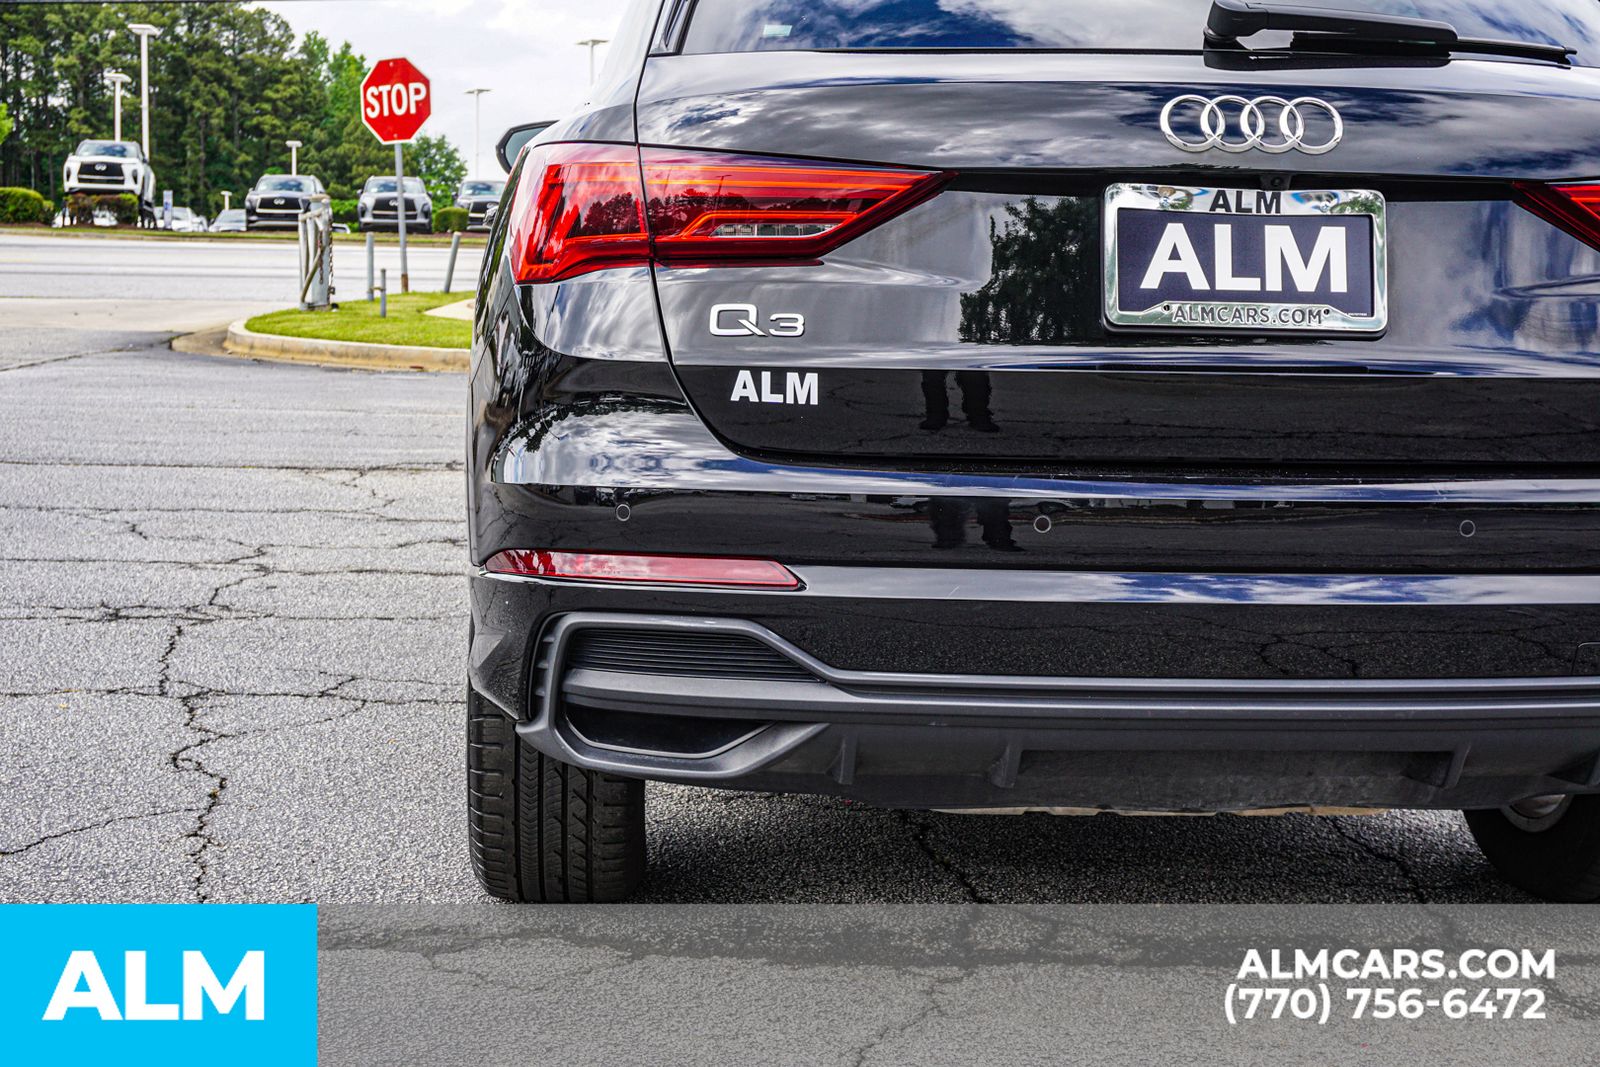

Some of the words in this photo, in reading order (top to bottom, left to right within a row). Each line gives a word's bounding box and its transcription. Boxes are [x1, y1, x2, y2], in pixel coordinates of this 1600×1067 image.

[366, 82, 426, 118] STOP
[1209, 190, 1282, 214] ALM
[1139, 222, 1348, 293] ALM
[709, 303, 805, 337] Q3
[1172, 305, 1322, 324] ALMCARS.COM
[730, 369, 819, 405] ALM
